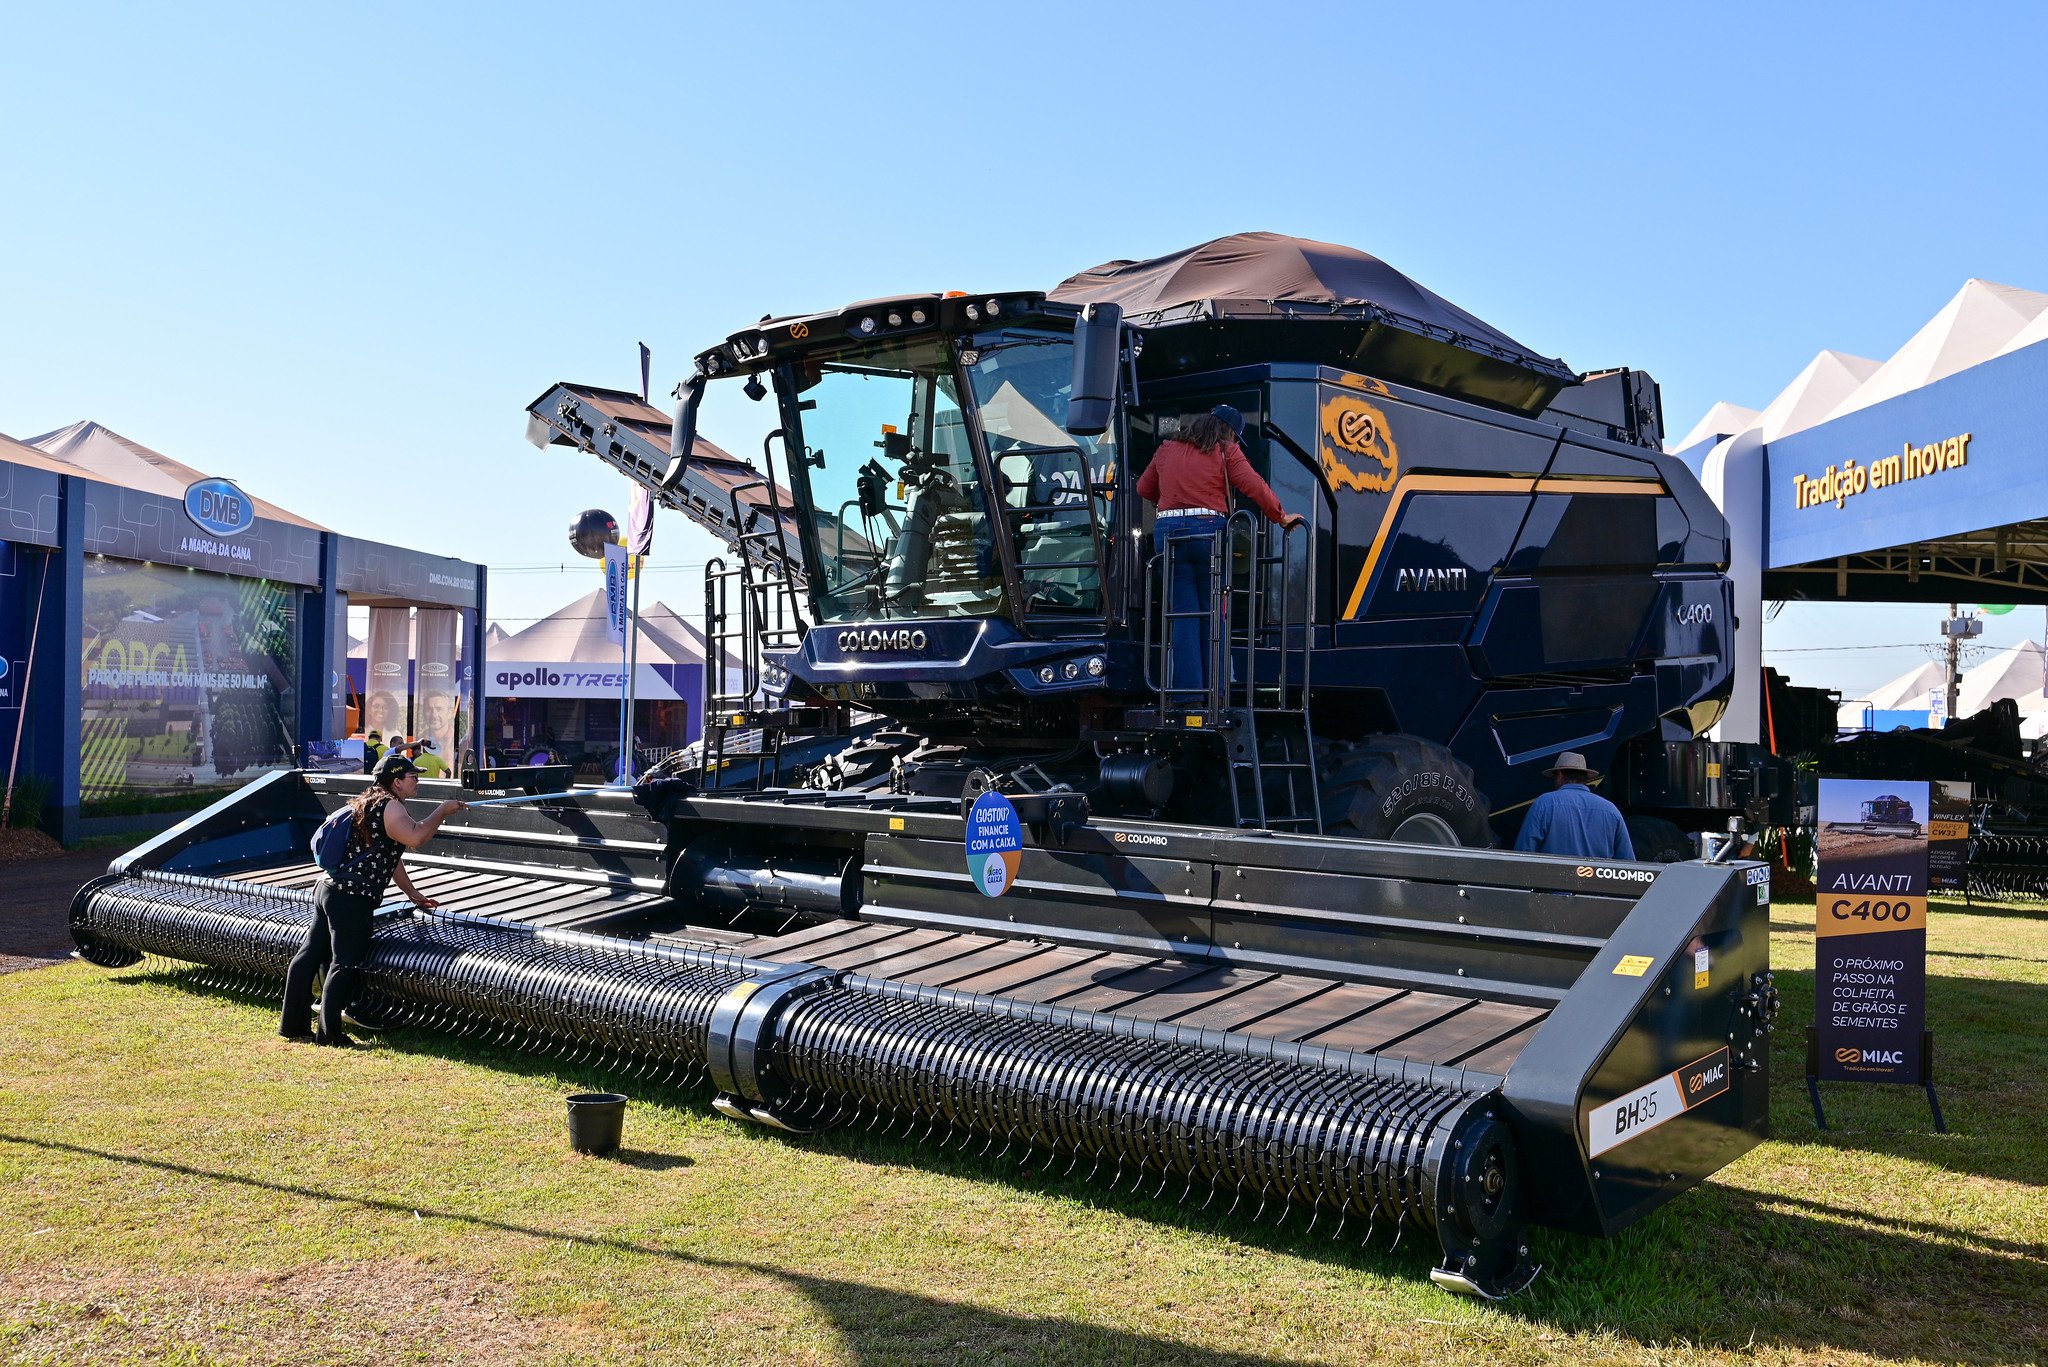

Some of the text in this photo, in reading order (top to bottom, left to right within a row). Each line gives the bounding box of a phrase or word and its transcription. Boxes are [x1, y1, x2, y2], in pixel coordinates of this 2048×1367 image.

[1793, 433, 1971, 509] Tradição em Inovar
[200, 489, 240, 526] DMB
[181, 537, 251, 560] A MARCA DA CANA
[1396, 568, 1467, 592] AVANTI
[620, 586, 625, 596] DA
[1678, 604, 1712, 625] C400
[837, 629, 927, 652] COLOMBO
[88, 668, 134, 688] PARQUE
[171, 671, 193, 687] COM
[194, 672, 217, 688] MAIS
[217, 673, 230, 688] DE
[231, 673, 240, 689] 50
[241, 674, 256, 689] MIL
[496, 668, 629, 690] apollo TYRES
[1382, 772, 1440, 817] 520/85
[976, 807, 1010, 823] GOSTOU?
[1933, 813, 1964, 821] WINFLEX
[979, 824, 1009, 836] FINANCIE
[1932, 829, 1956, 837] CW33
[971, 837, 1016, 851] COM A CAIXA
[1128, 834, 1168, 846] COLOMBO
[987, 876, 1002, 884] CAIXA
[1596, 868, 1655, 882] COLOMBO
[1832, 873, 1911, 891] AVANTI
[1831, 900, 1911, 922] C400
[1833, 957, 1904, 970] O PRÓXIMO
[1833, 973, 1895, 984] PASSO NA
[1833, 987, 1895, 999] COLHEITA
[1832, 1000, 1907, 1014] DE GRÃOS E
[1832, 1016, 1898, 1028] SEMENTES
[1862, 1050, 1903, 1064] MIAC
[1702, 1063, 1724, 1086] MIAC
[1615, 1091, 1657, 1135] BH35
